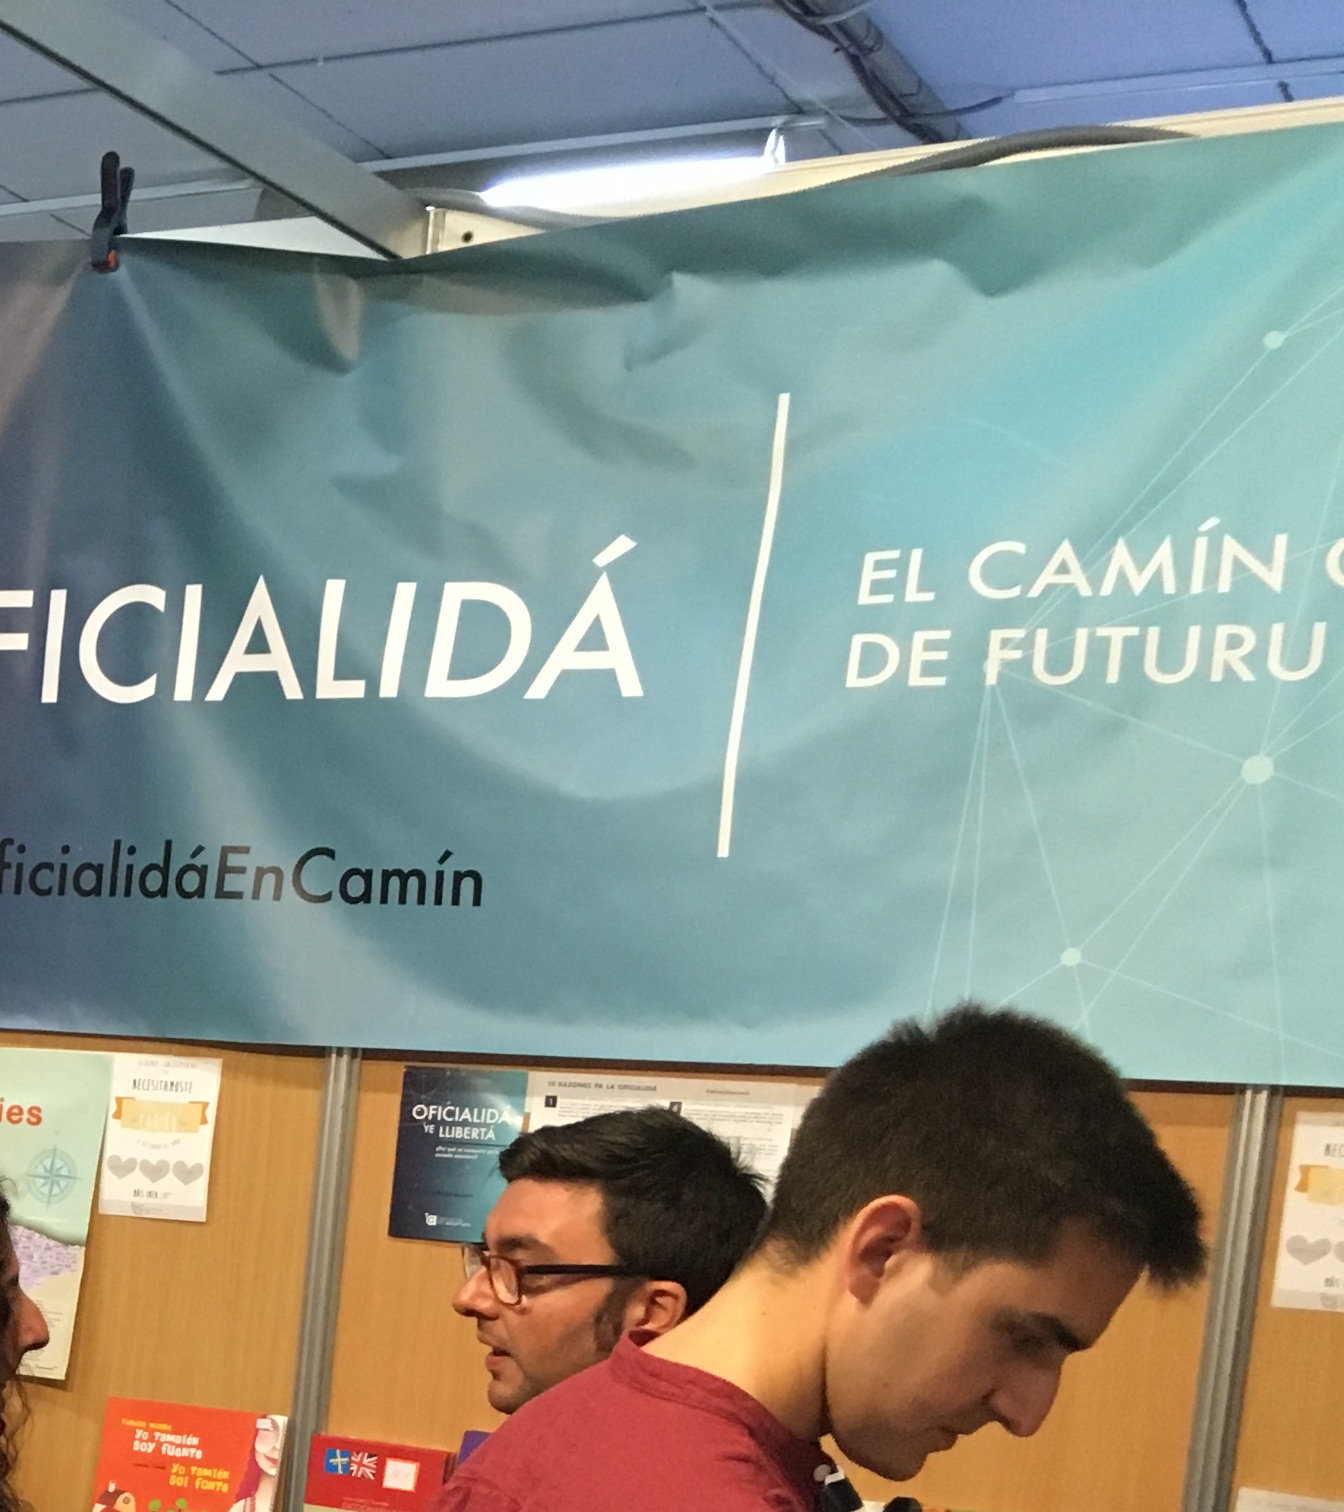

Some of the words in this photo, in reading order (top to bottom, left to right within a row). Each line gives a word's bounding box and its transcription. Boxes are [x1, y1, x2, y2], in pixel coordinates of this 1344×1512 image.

[857, 547, 936, 606] EL
[968, 515, 1289, 600] CAMÍN
[845, 629, 952, 688] DE
[985, 620, 1328, 686] FUTURU
[411, 1104, 512, 1126] OFICIALIDÁ
